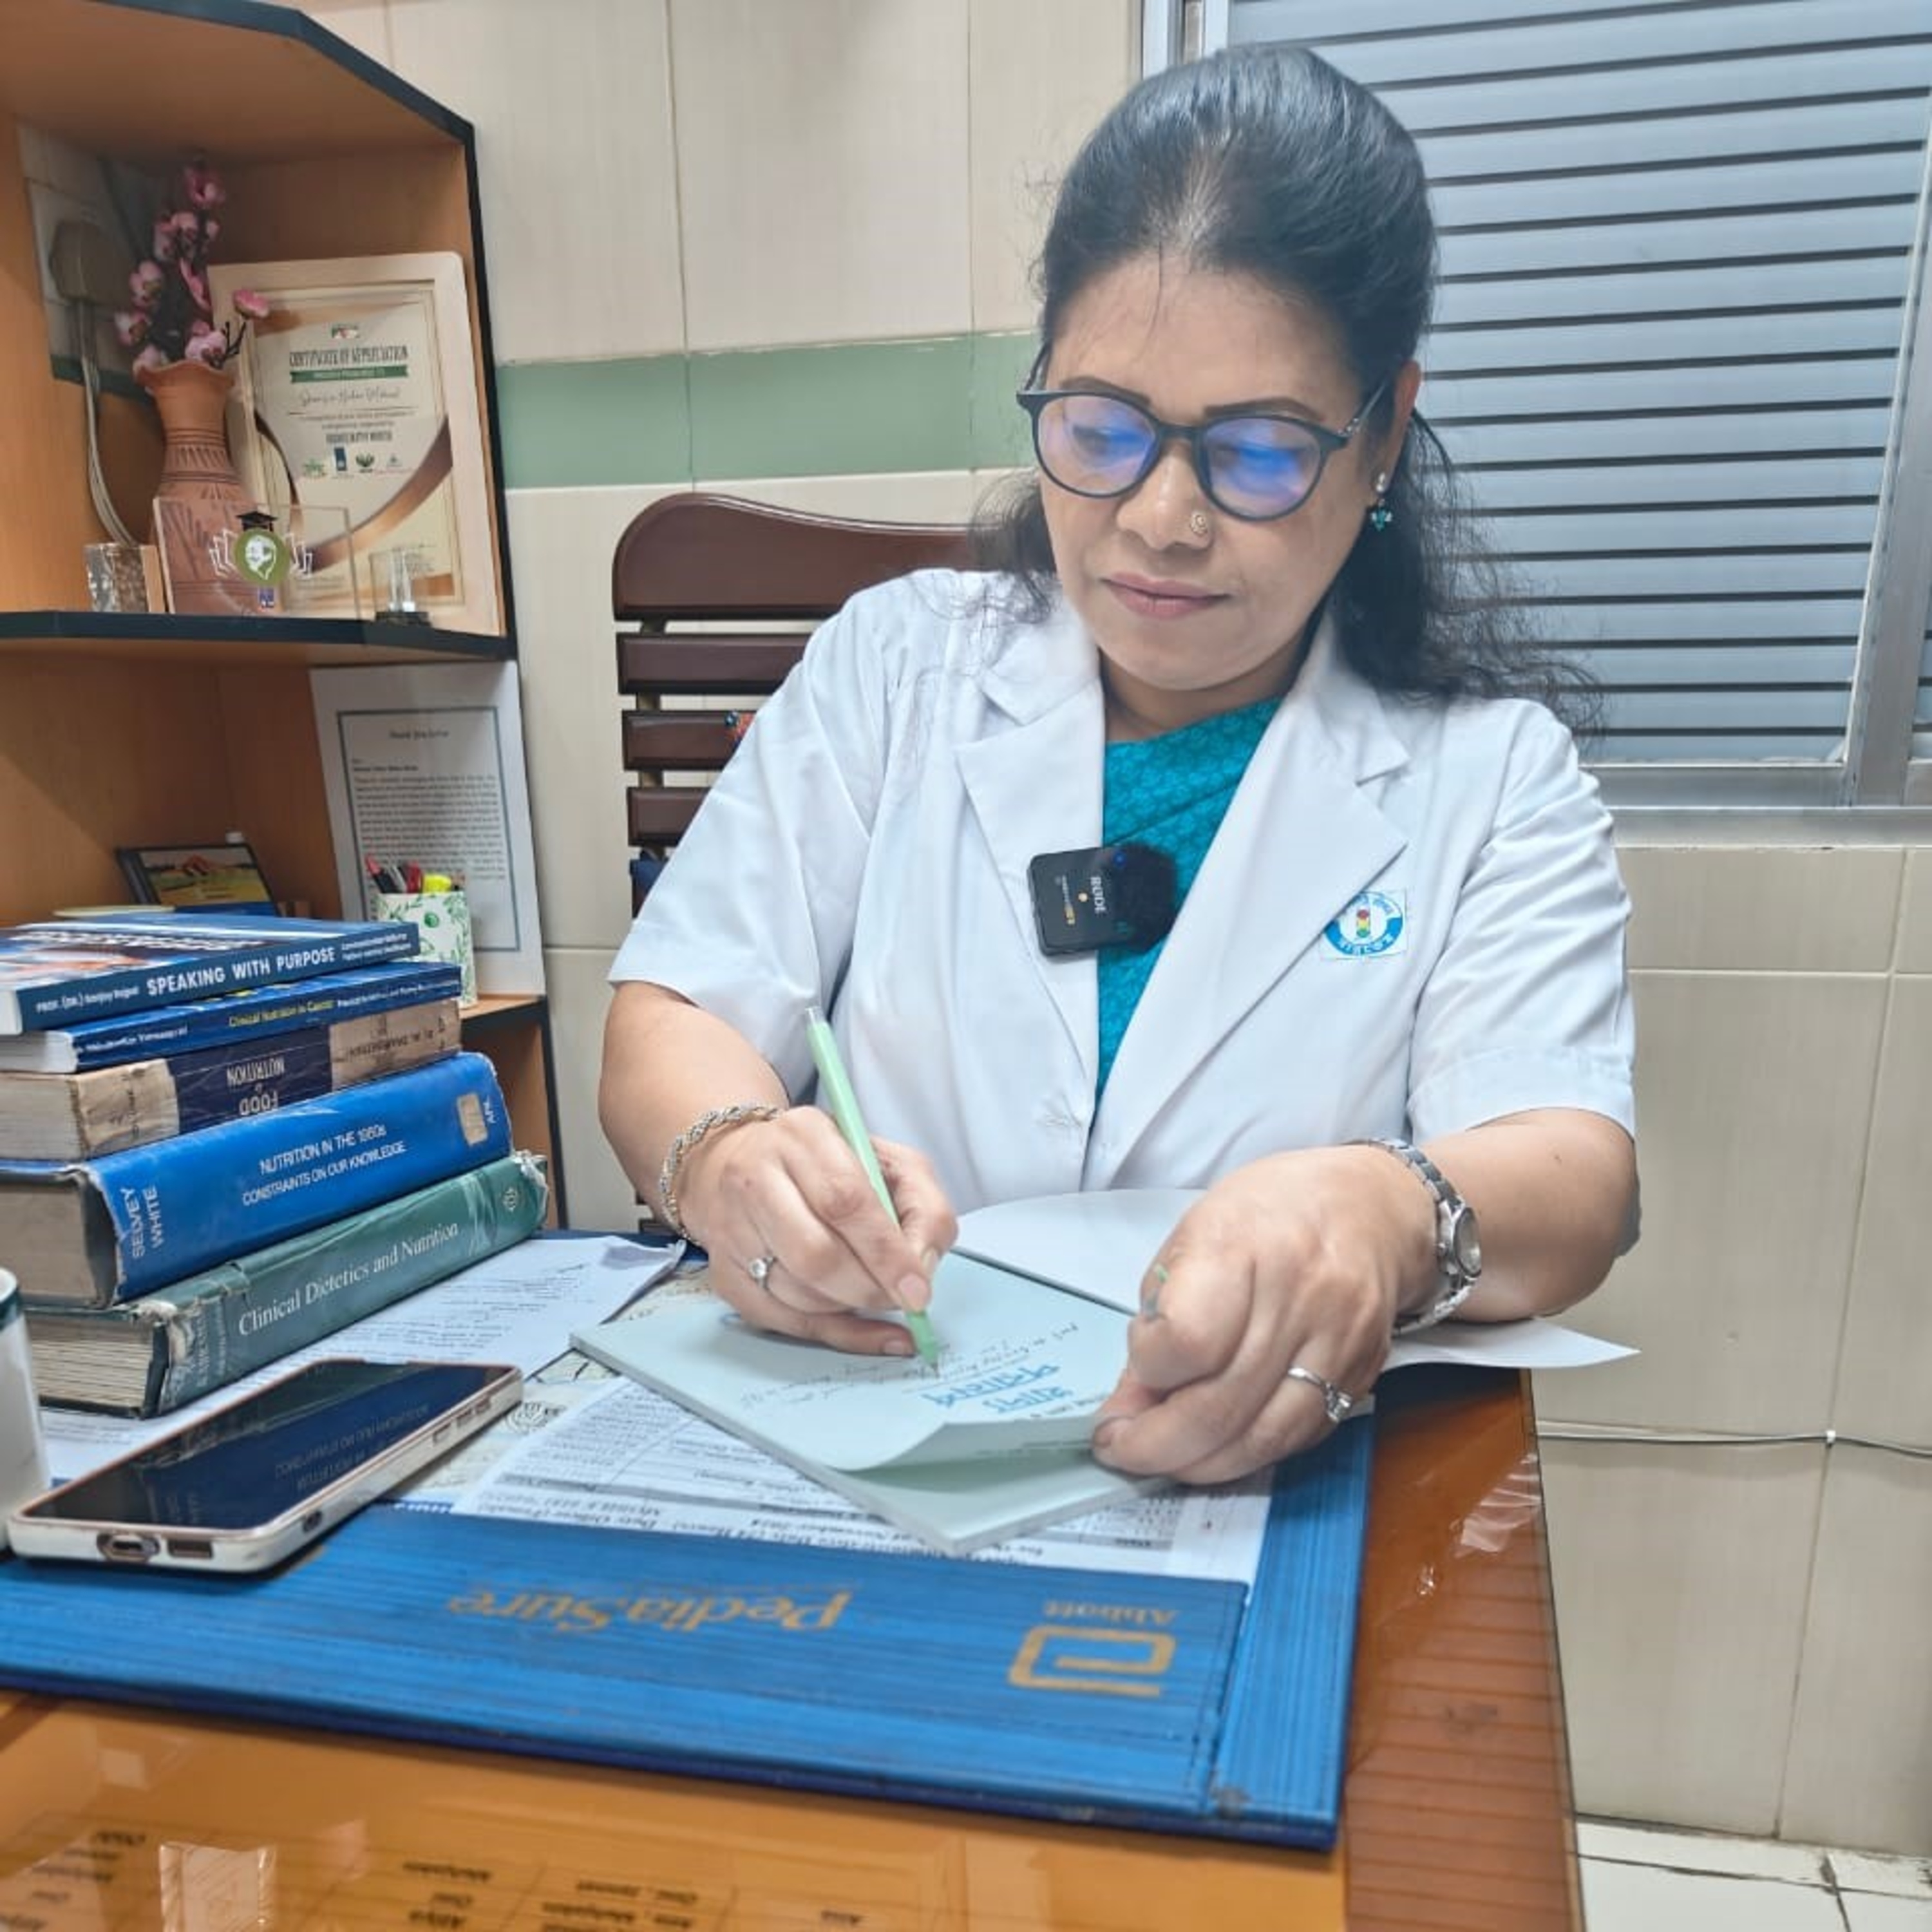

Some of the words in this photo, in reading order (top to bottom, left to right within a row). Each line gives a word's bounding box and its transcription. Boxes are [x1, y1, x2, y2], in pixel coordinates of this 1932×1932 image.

[146, 967, 225, 996] SPEAKING
[232, 959, 270, 981] WITH
[277, 947, 336, 971] PURPOSE
[239, 1090, 278, 1115] FOOD
[242, 1172, 310, 1206] CONSTRAINTS
[312, 1168, 327, 1182] ON
[328, 1159, 349, 1177] OUR
[350, 1141, 407, 1170] KNOWLEDGE
[260, 1142, 320, 1175] NUTRITION
[322, 1139, 333, 1154] IN
[334, 1131, 355, 1150] THE
[120, 1188, 146, 1258] SELVEY
[143, 1185, 164, 1248] WHITE
[239, 1292, 301, 1336] Clinical
[305, 1264, 370, 1305] Dietetics
[373, 1248, 399, 1276] and
[401, 1221, 459, 1258] Nutrition
